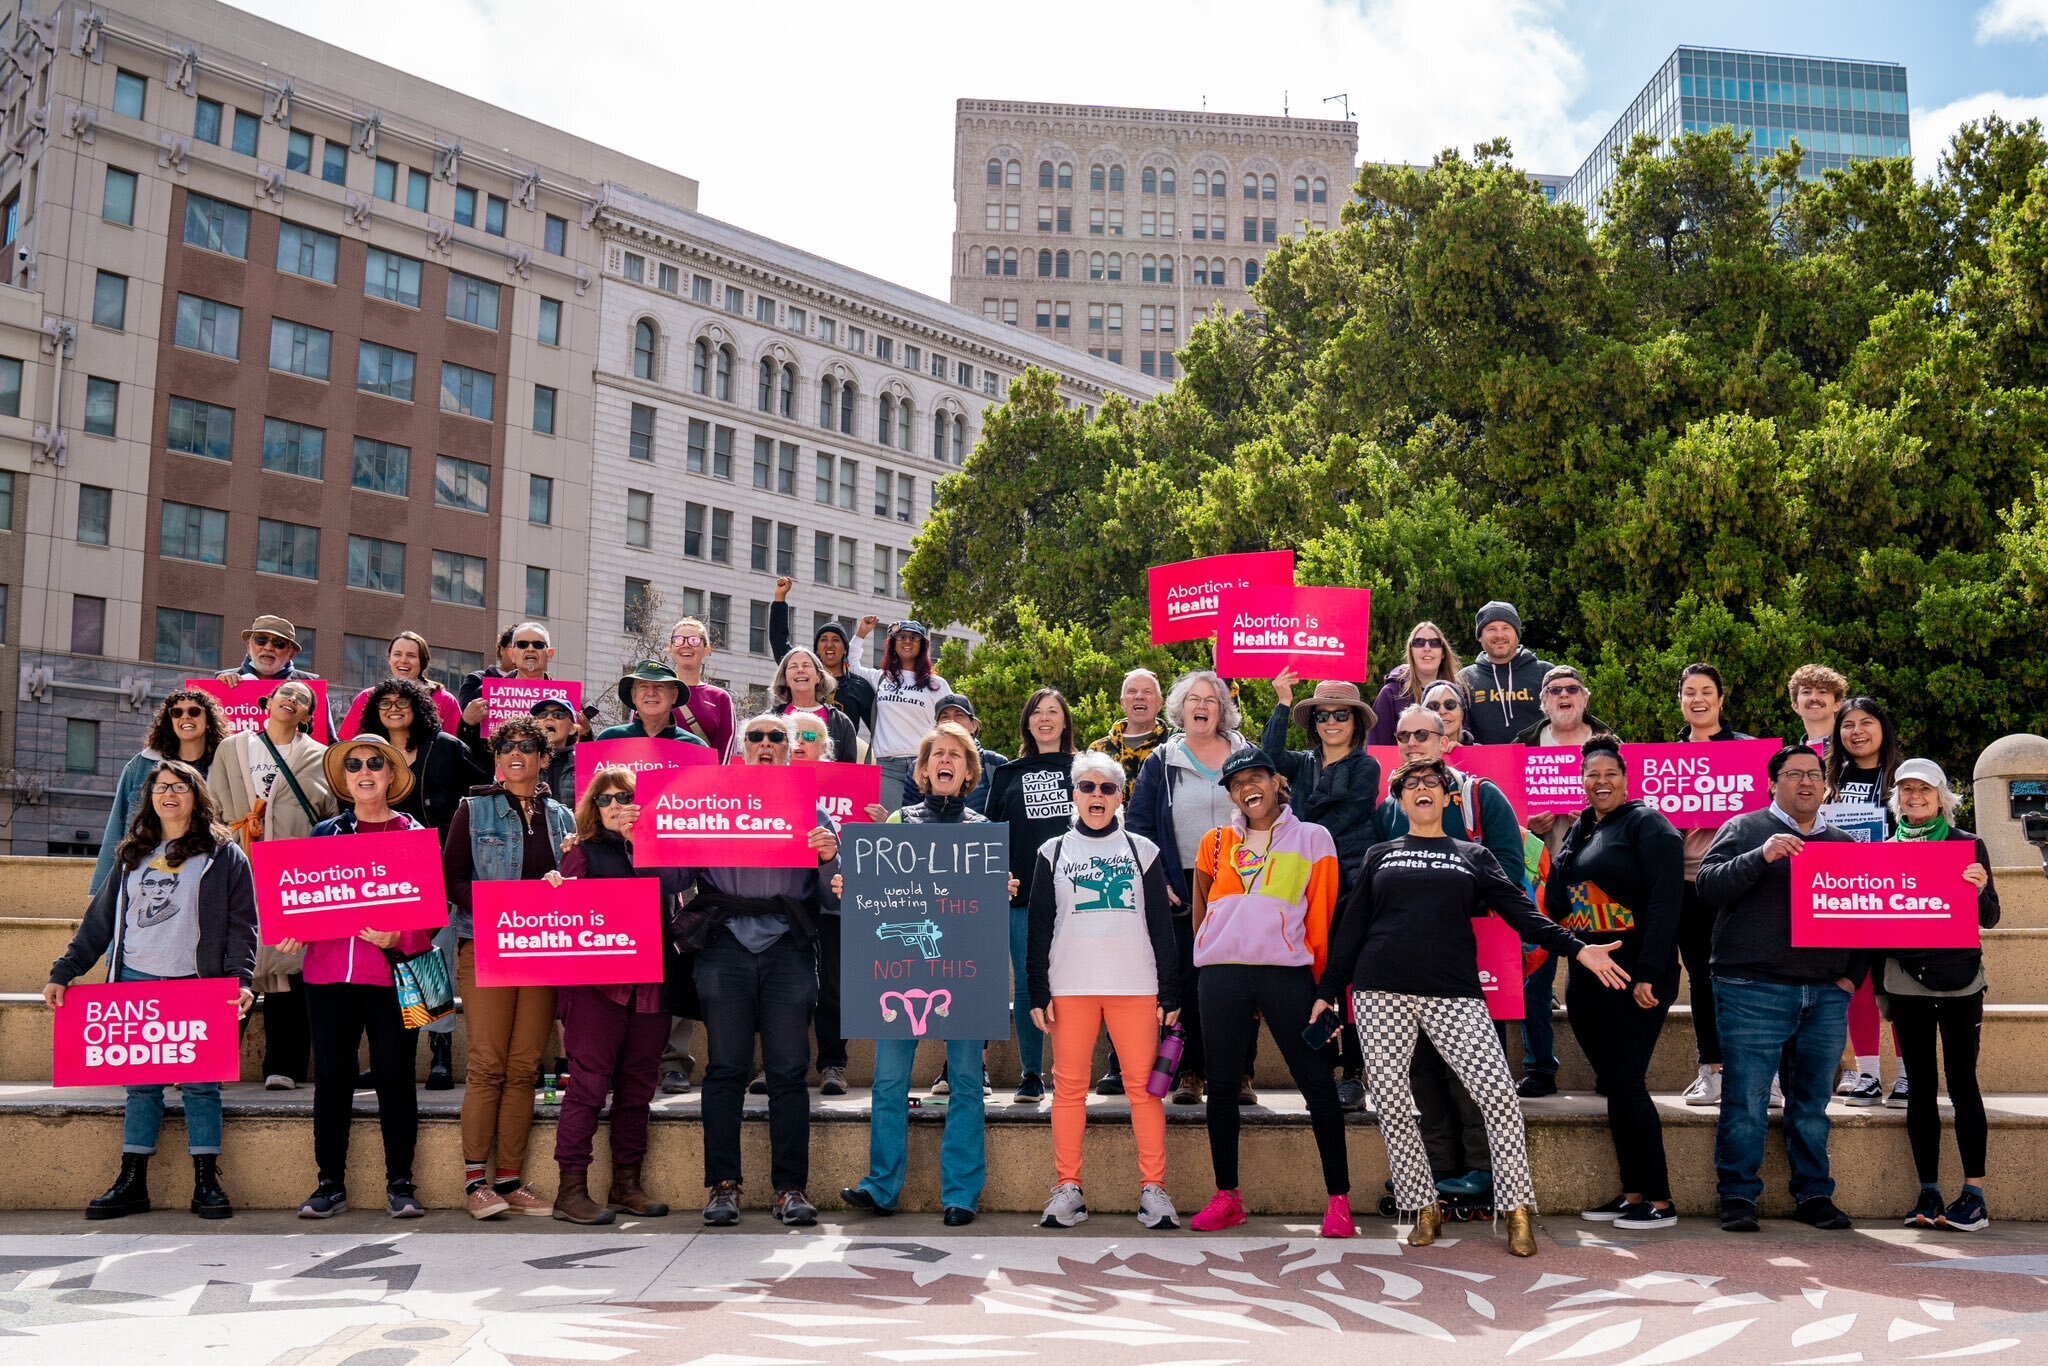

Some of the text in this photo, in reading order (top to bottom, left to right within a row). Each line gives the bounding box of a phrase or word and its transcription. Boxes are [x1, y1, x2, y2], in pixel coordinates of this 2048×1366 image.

[1167, 578, 1233, 600] Abortion
[1233, 613, 1318, 628] Abortion is
[1233, 631, 1345, 649] Health Care.
[489, 686, 567, 699] LATINAS FOR
[878, 694, 926, 708] ealthcare
[1490, 688, 1534, 701] kind.
[217, 703, 268, 715] bortion
[489, 698, 541, 709] PLANNE
[227, 718, 259, 731] alth
[1527, 755, 1576, 764] STAND
[1643, 757, 1710, 776] BANS
[1023, 771, 1062, 781] STAND
[1641, 774, 1755, 794] OFF OUR
[1024, 781, 1056, 791] WITH
[656, 794, 762, 810] Abortion is
[1025, 790, 1065, 803] BLACK
[1643, 793, 1744, 813] BODIES
[816, 796, 853, 816] UR
[656, 813, 793, 830] Health Care.
[855, 837, 1005, 876] PRO-LIFE
[1382, 850, 1462, 863] Abortion is
[279, 862, 387, 886] Abortion is
[1063, 862, 1088, 876] Who
[884, 881, 949, 896] would be
[1068, 872, 1092, 893] You
[1094, 871, 1107, 879] or
[1812, 872, 1917, 889] Abortion is
[281, 881, 420, 906] Health Care.
[1812, 893, 1950, 910] Health Care.
[856, 894, 980, 915] Regulating THIS
[497, 910, 604, 928] Abortion is
[498, 930, 636, 949] Health Care.
[874, 959, 977, 980] NOT THIS
[86, 1000, 160, 1022] BANS
[83, 1020, 208, 1045] OFF OUR
[85, 1042, 197, 1067] BODIES
